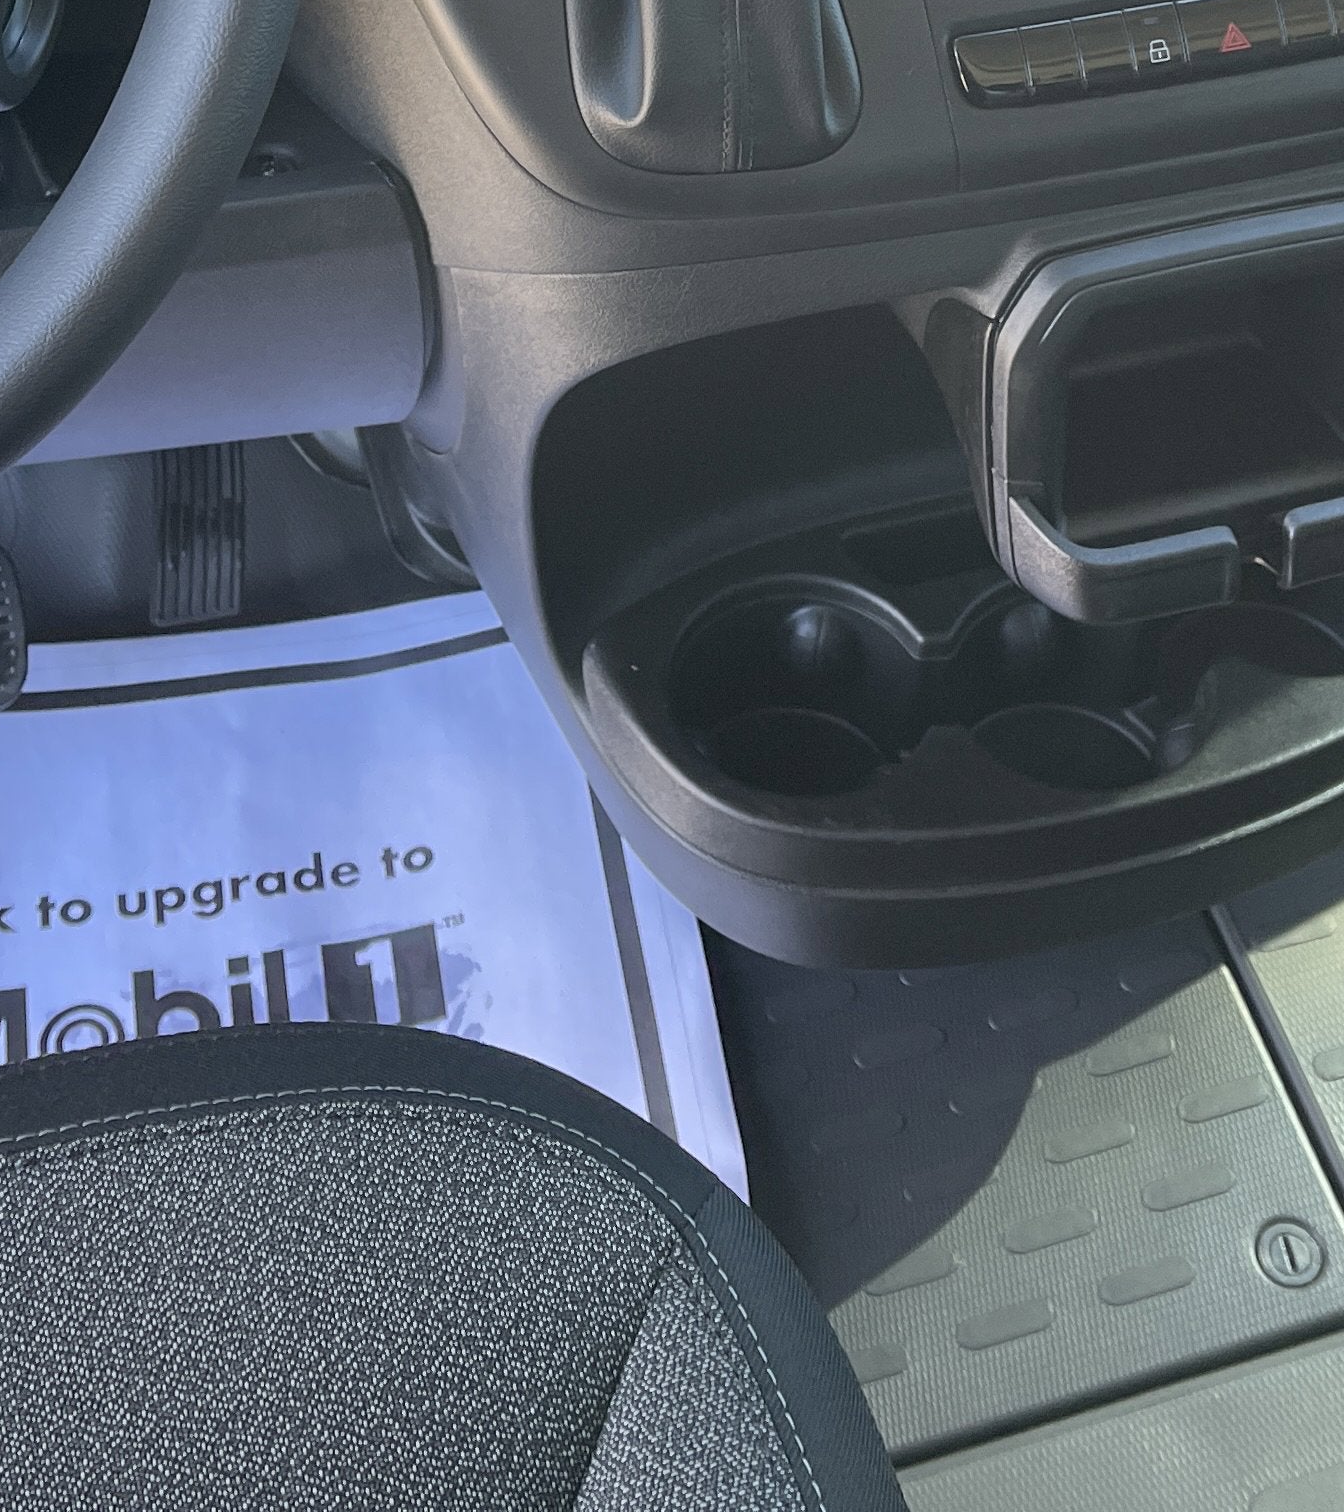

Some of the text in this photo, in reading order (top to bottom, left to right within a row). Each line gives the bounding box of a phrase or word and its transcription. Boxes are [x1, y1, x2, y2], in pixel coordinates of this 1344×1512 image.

[35, 895, 93, 928] to
[117, 852, 359, 925] upgrade
[381, 844, 435, 879] to
